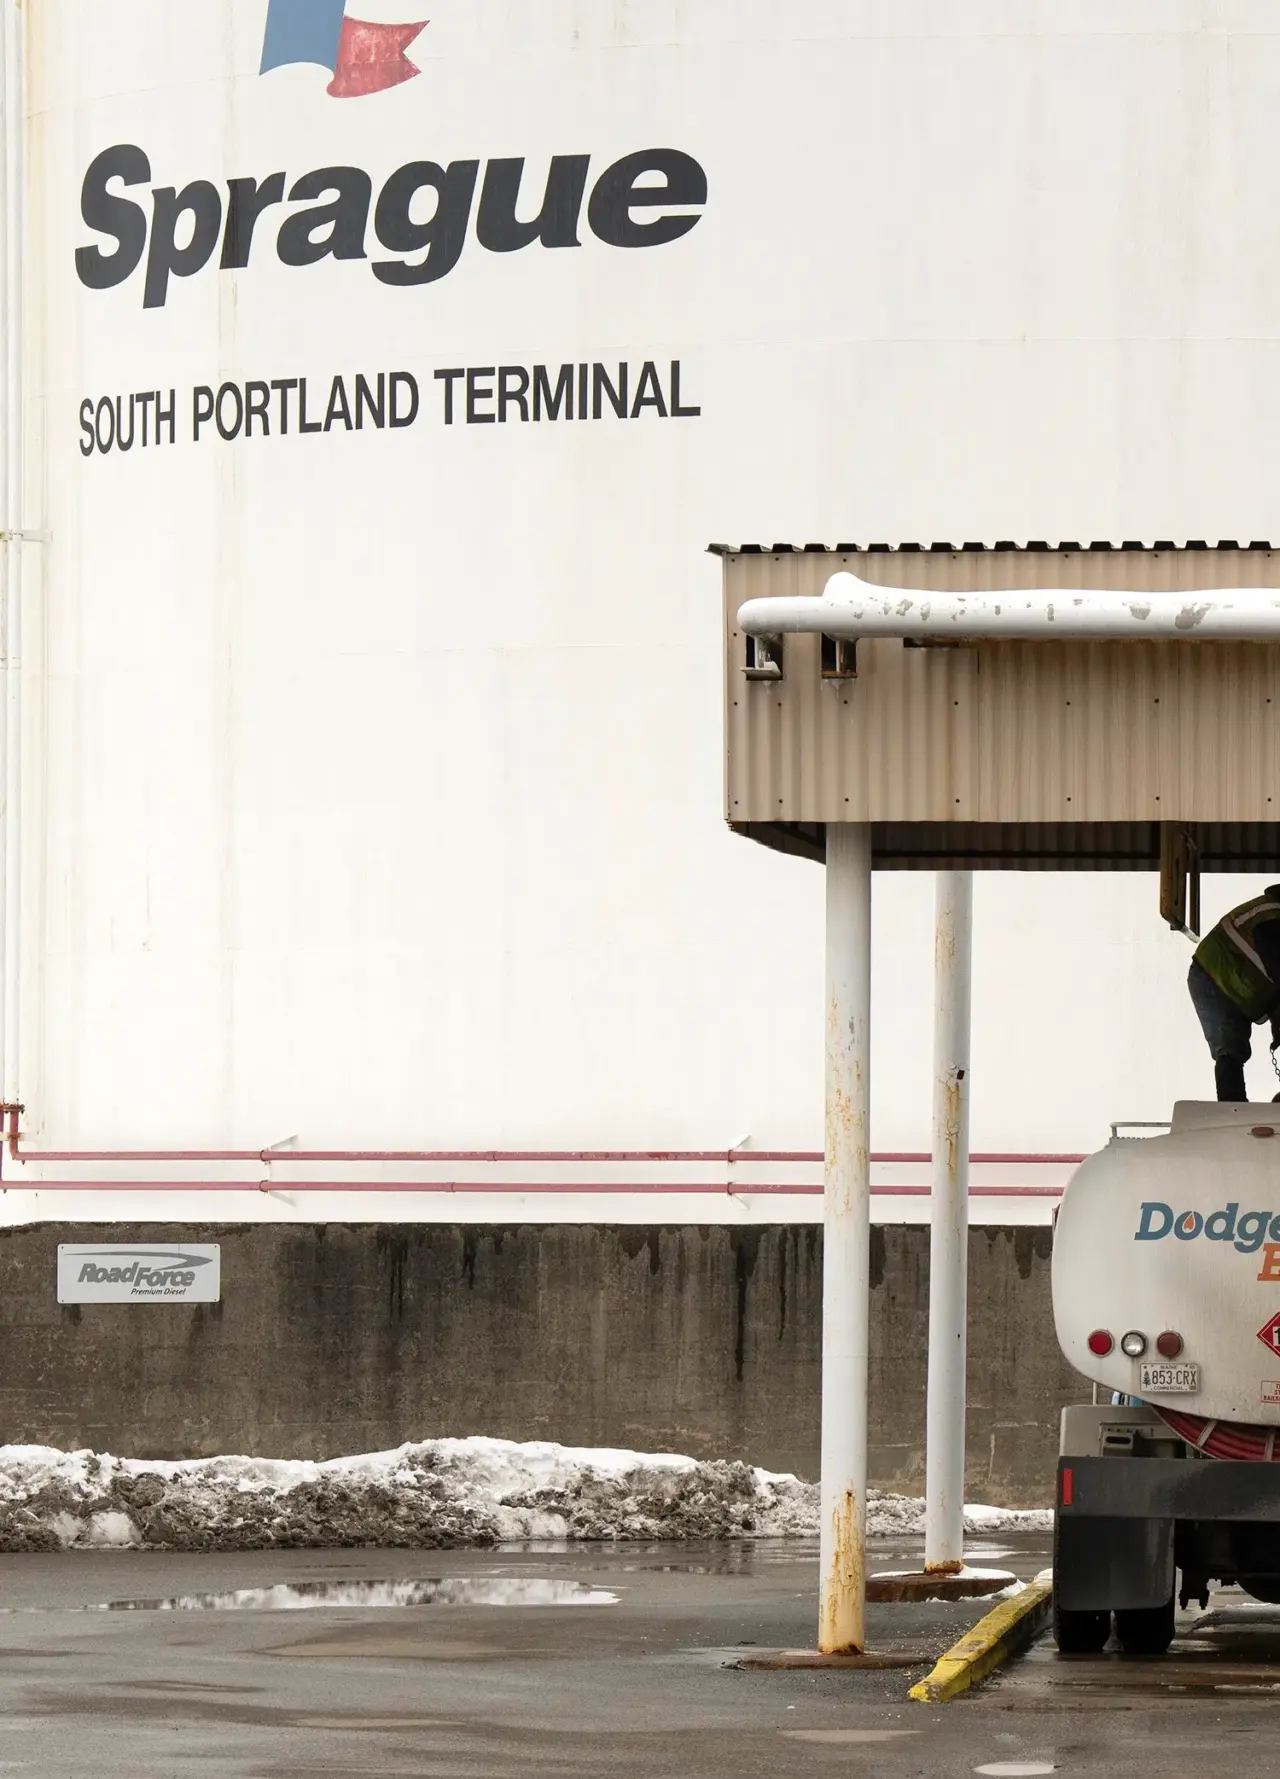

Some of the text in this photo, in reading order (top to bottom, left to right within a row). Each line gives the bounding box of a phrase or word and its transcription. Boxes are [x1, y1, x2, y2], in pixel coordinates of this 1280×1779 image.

[75, 143, 708, 309] Sprague
[79, 359, 701, 457] SOUTH PORTLAND TERMINAL
[78, 1262, 195, 1287] RoadForce
[131, 1288, 186, 1296] Premium Diesel
